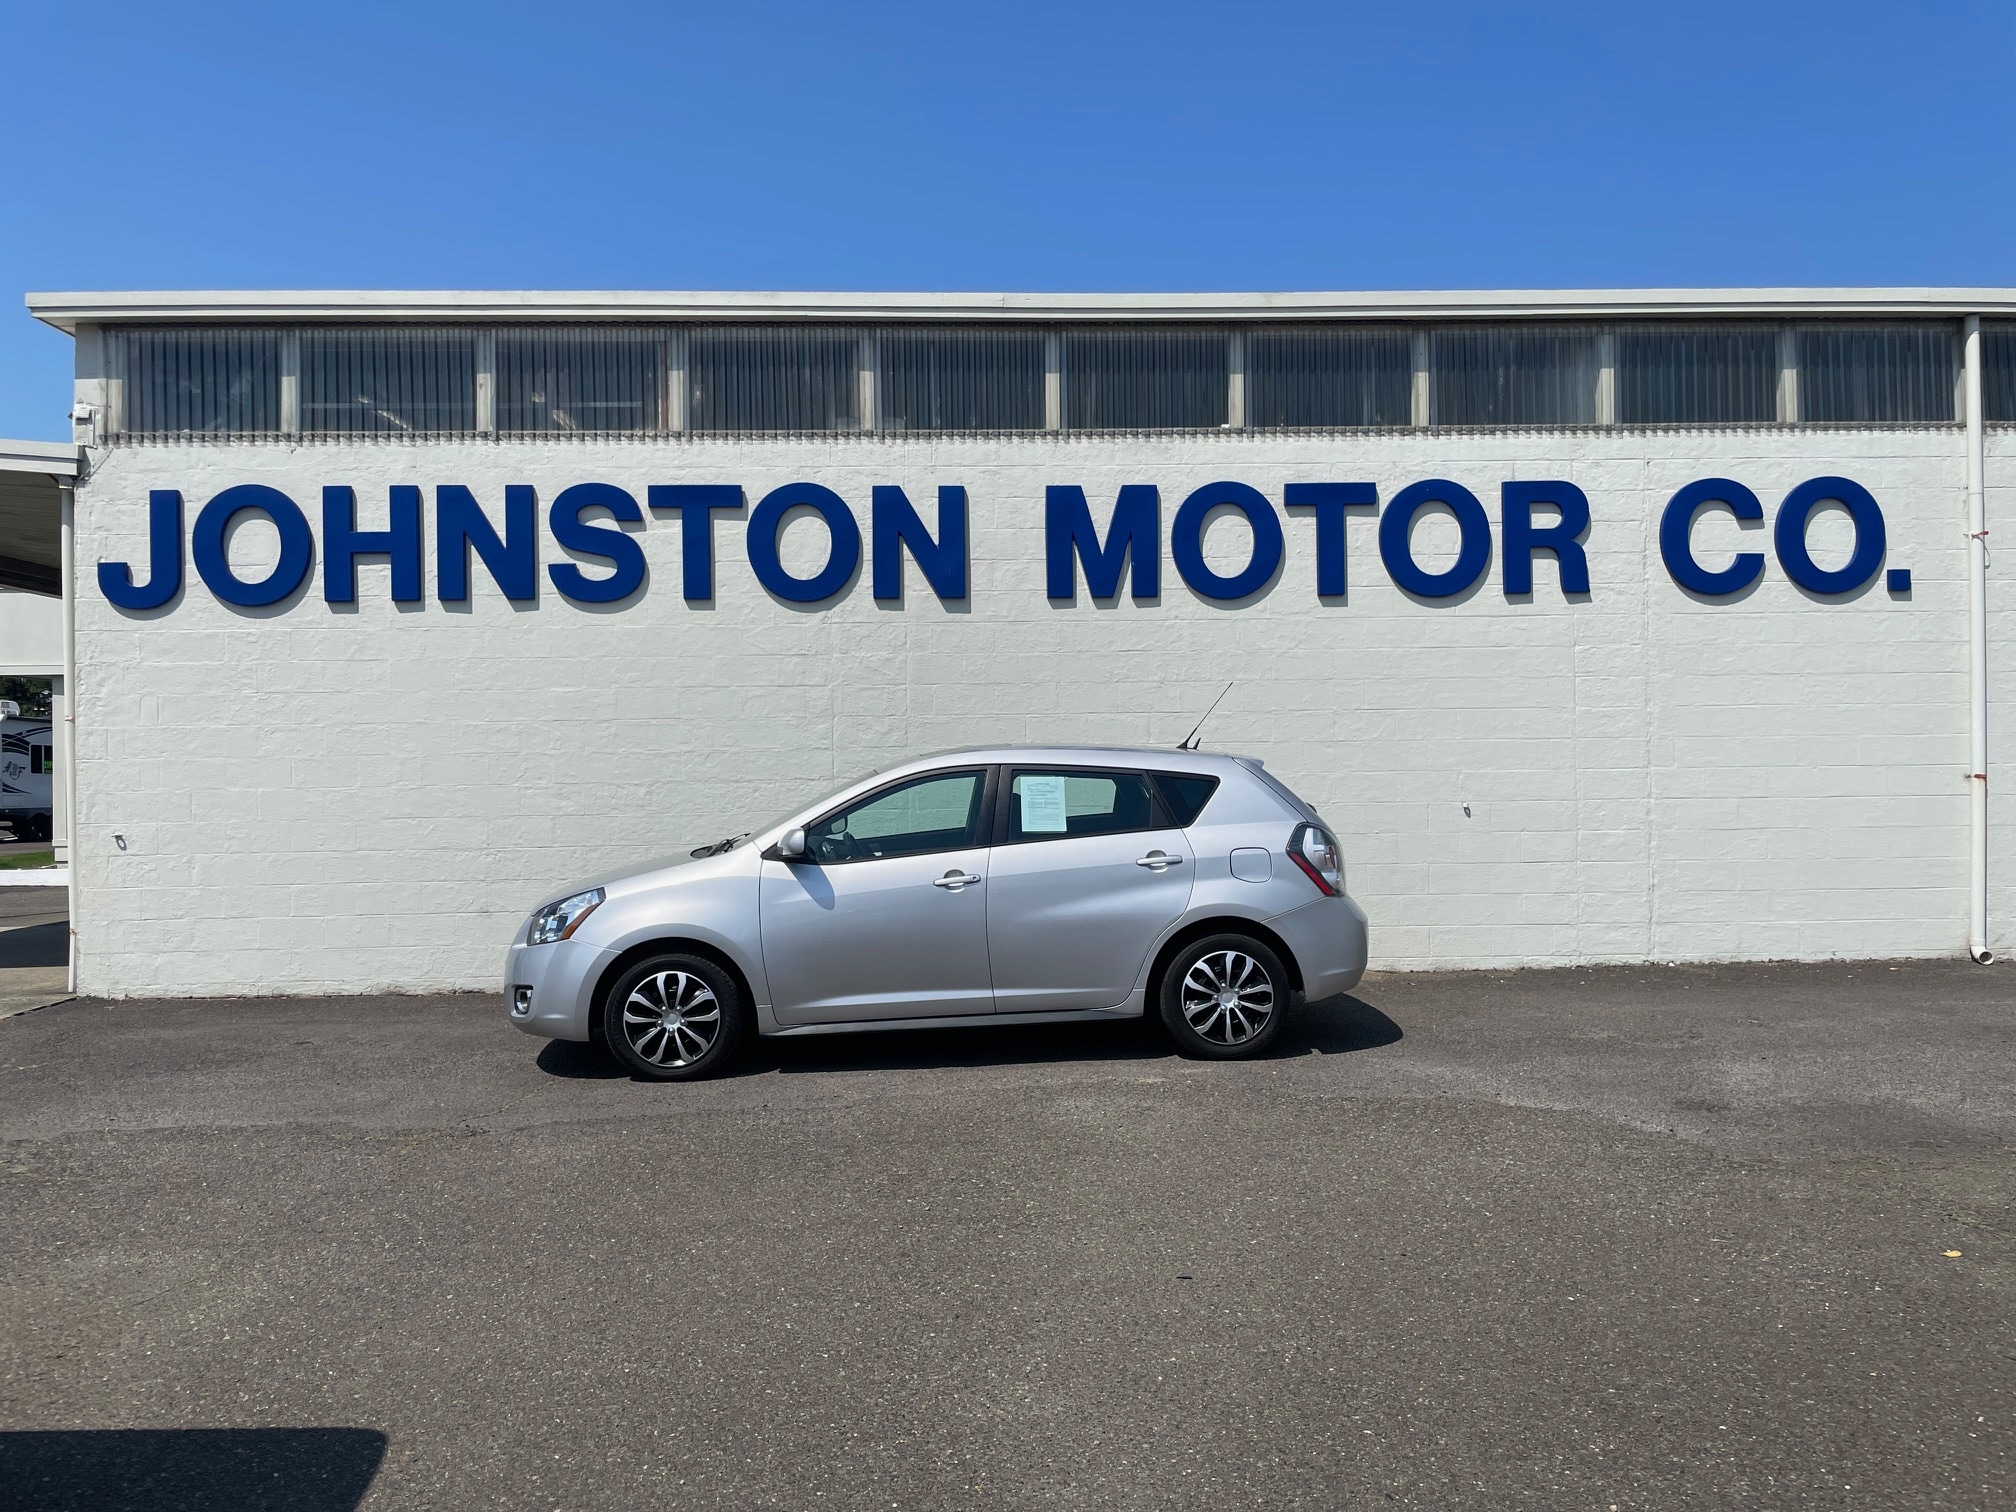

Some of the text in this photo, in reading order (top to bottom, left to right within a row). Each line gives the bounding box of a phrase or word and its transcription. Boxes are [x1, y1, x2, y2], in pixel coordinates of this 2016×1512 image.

[98, 477, 1911, 610] JOHNSTON MOTOR CO.
